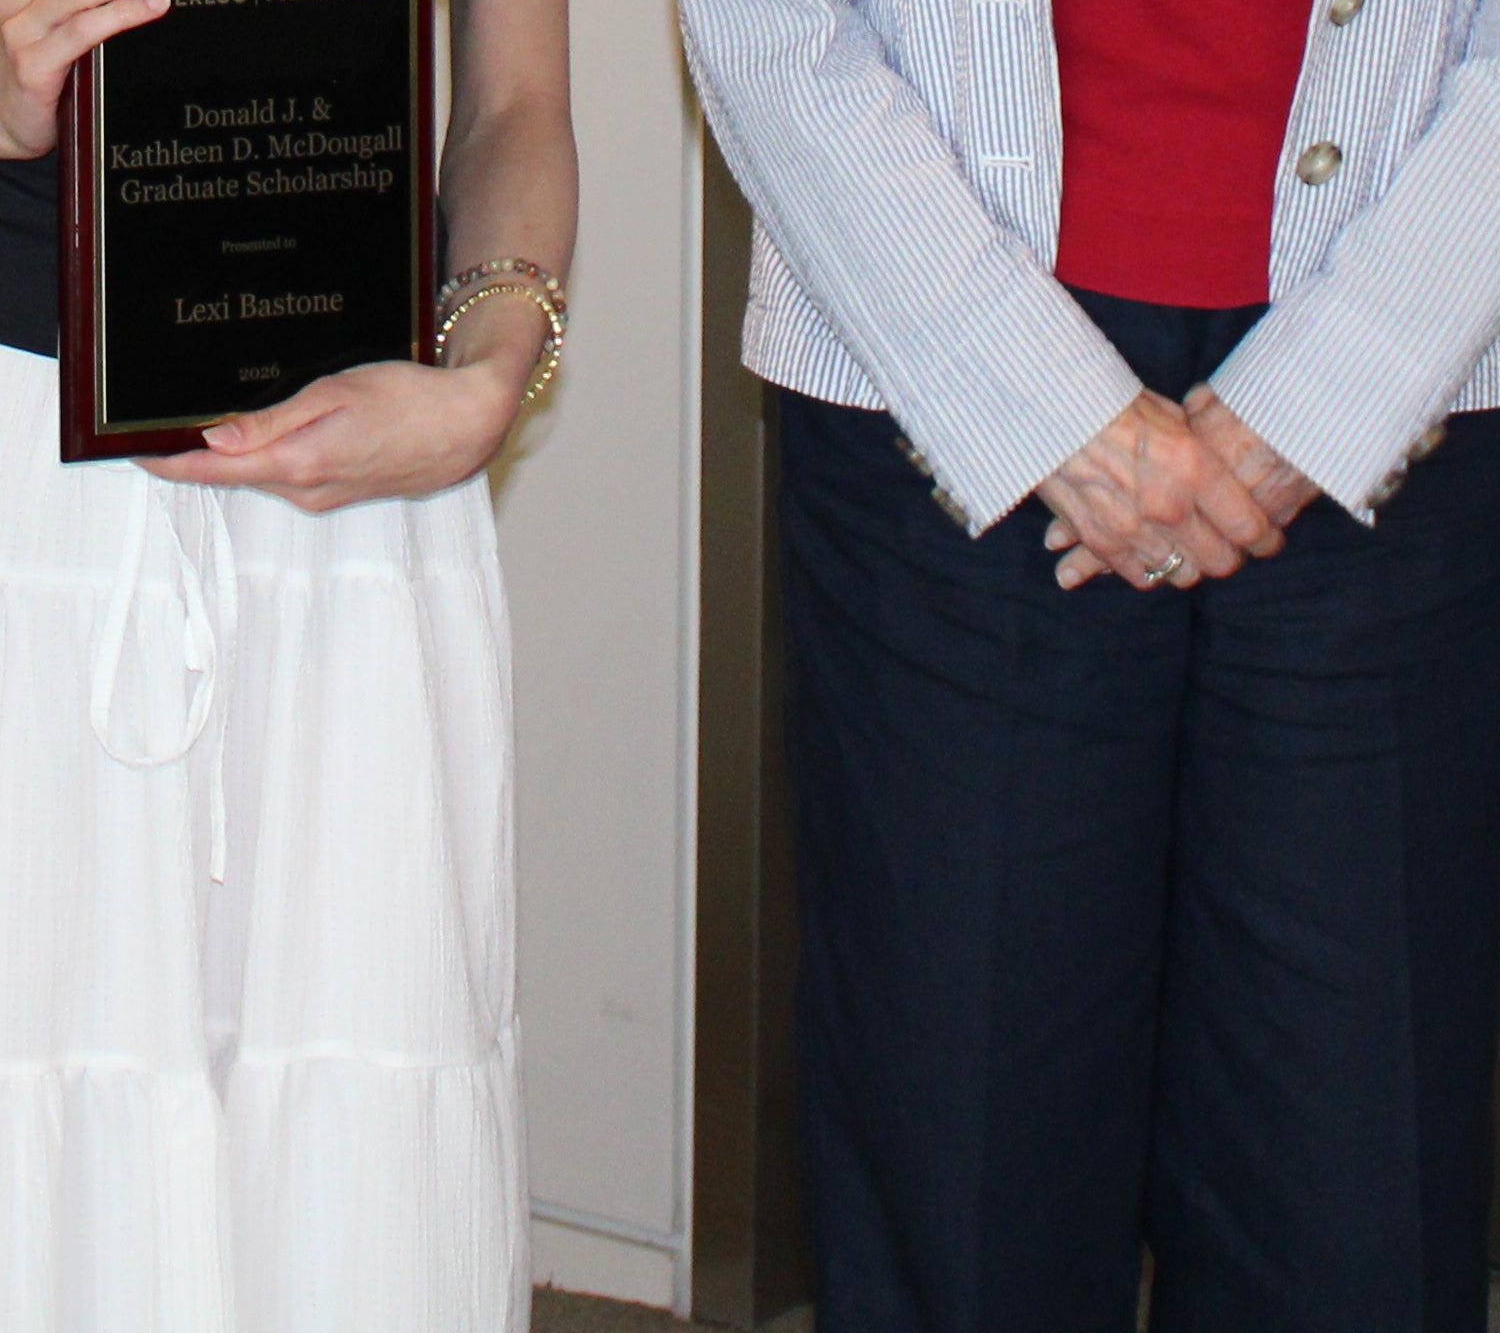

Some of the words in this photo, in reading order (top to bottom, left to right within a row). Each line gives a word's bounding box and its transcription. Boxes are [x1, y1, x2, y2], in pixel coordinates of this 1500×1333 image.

[184, 99, 275, 128] Donald
[281, 98, 303, 123] J.
[312, 96, 332, 121] &
[110, 140, 224, 170] Kathleen
[232, 137, 260, 161] D.
[268, 125, 403, 159] McDougall
[121, 175, 240, 205] Graduate
[247, 163, 394, 196] Scholarship
[222, 237, 281, 253] Presented
[283, 237, 297, 249] to
[175, 294, 230, 324] Lexi
[239, 292, 344, 319] Bastone
[238, 362, 280, 381] 2026
